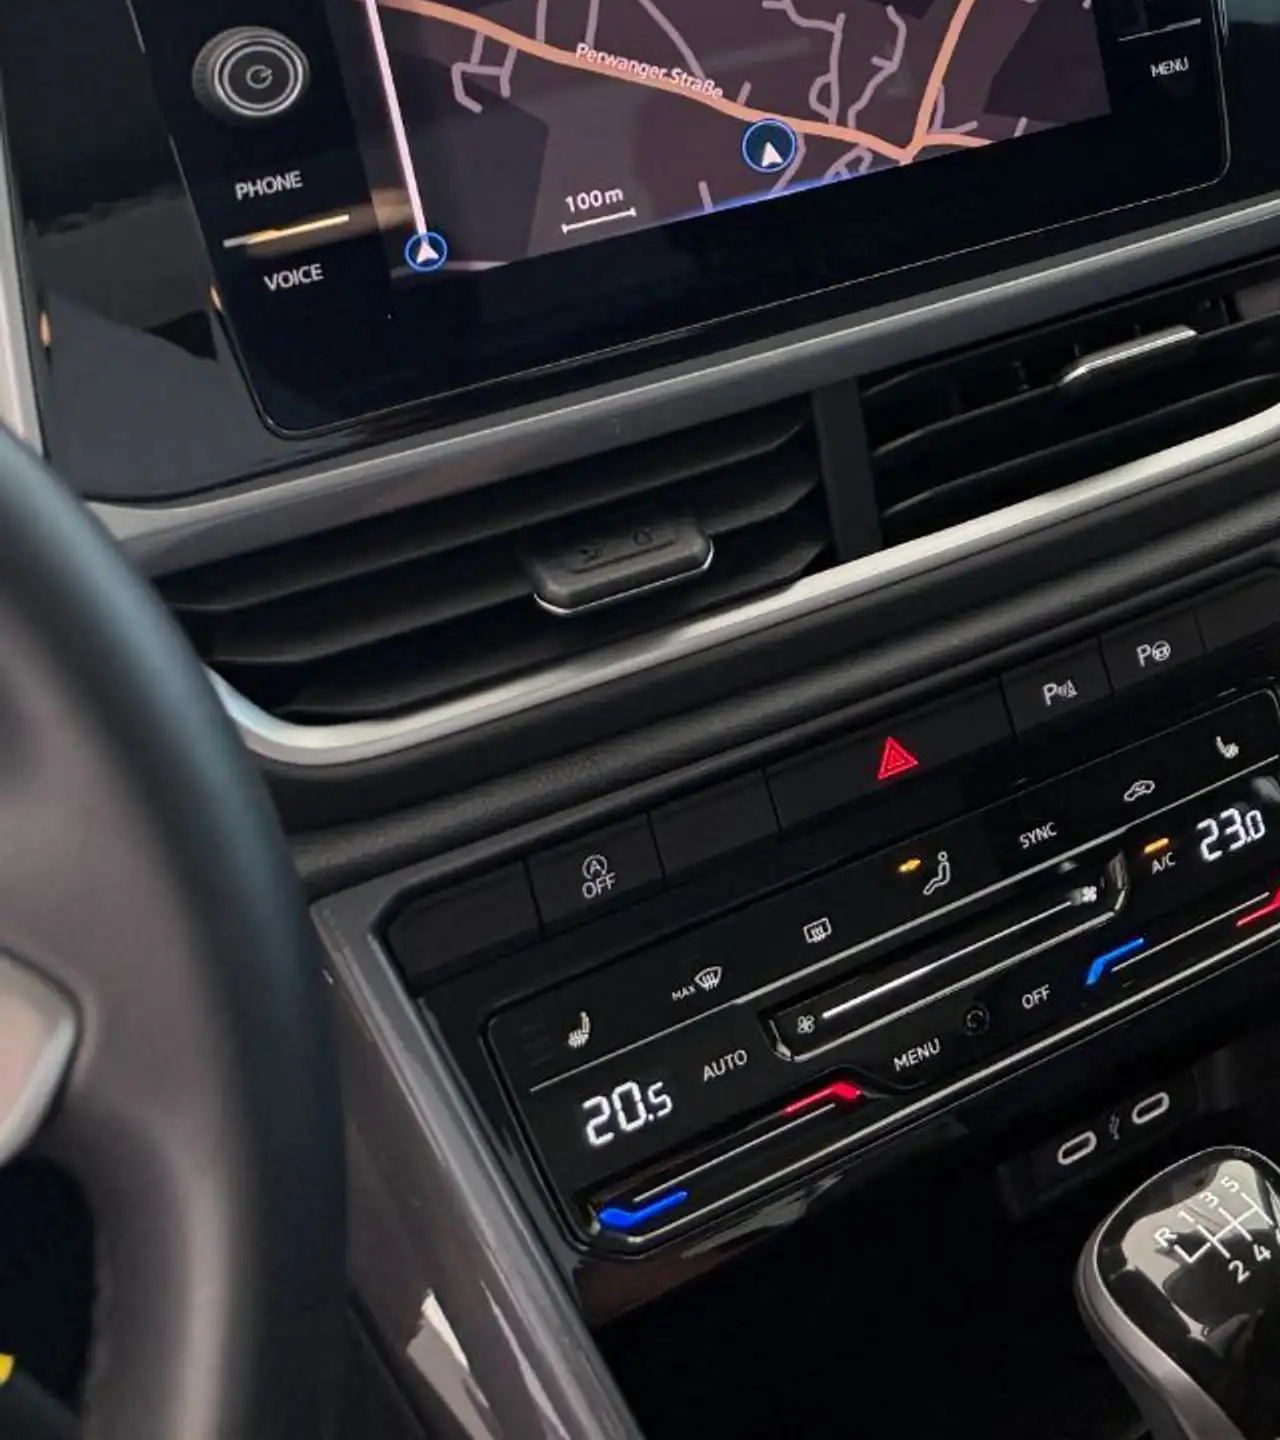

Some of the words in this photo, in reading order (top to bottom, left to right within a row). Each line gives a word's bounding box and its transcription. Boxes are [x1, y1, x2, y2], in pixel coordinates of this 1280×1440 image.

[575, 41, 668, 80] Perwanger
[670, 67, 724, 101] Straße
[1150, 56, 1189, 79] MENU
[235, 169, 303, 201] PHONE
[264, 263, 324, 292] VOICE
[1019, 821, 1058, 849] SYNC
[1196, 807, 1266, 862] 23.0
[1151, 851, 1177, 875] A/C
[582, 871, 616, 899] OFF
[671, 984, 696, 1002] MAX
[1021, 984, 1051, 1010] OFF
[702, 1048, 748, 1082] AUTO
[893, 1037, 942, 1072] MENU
[581, 1079, 674, 1148] 20.5
[1220, 1175, 1240, 1194] 5
[1199, 1190, 1220, 1210] 3
[1177, 1209, 1196, 1225] 1
[1152, 1226, 1178, 1249] R
[1249, 1242, 1272, 1263] 4
[1227, 1259, 1250, 1284] 2
